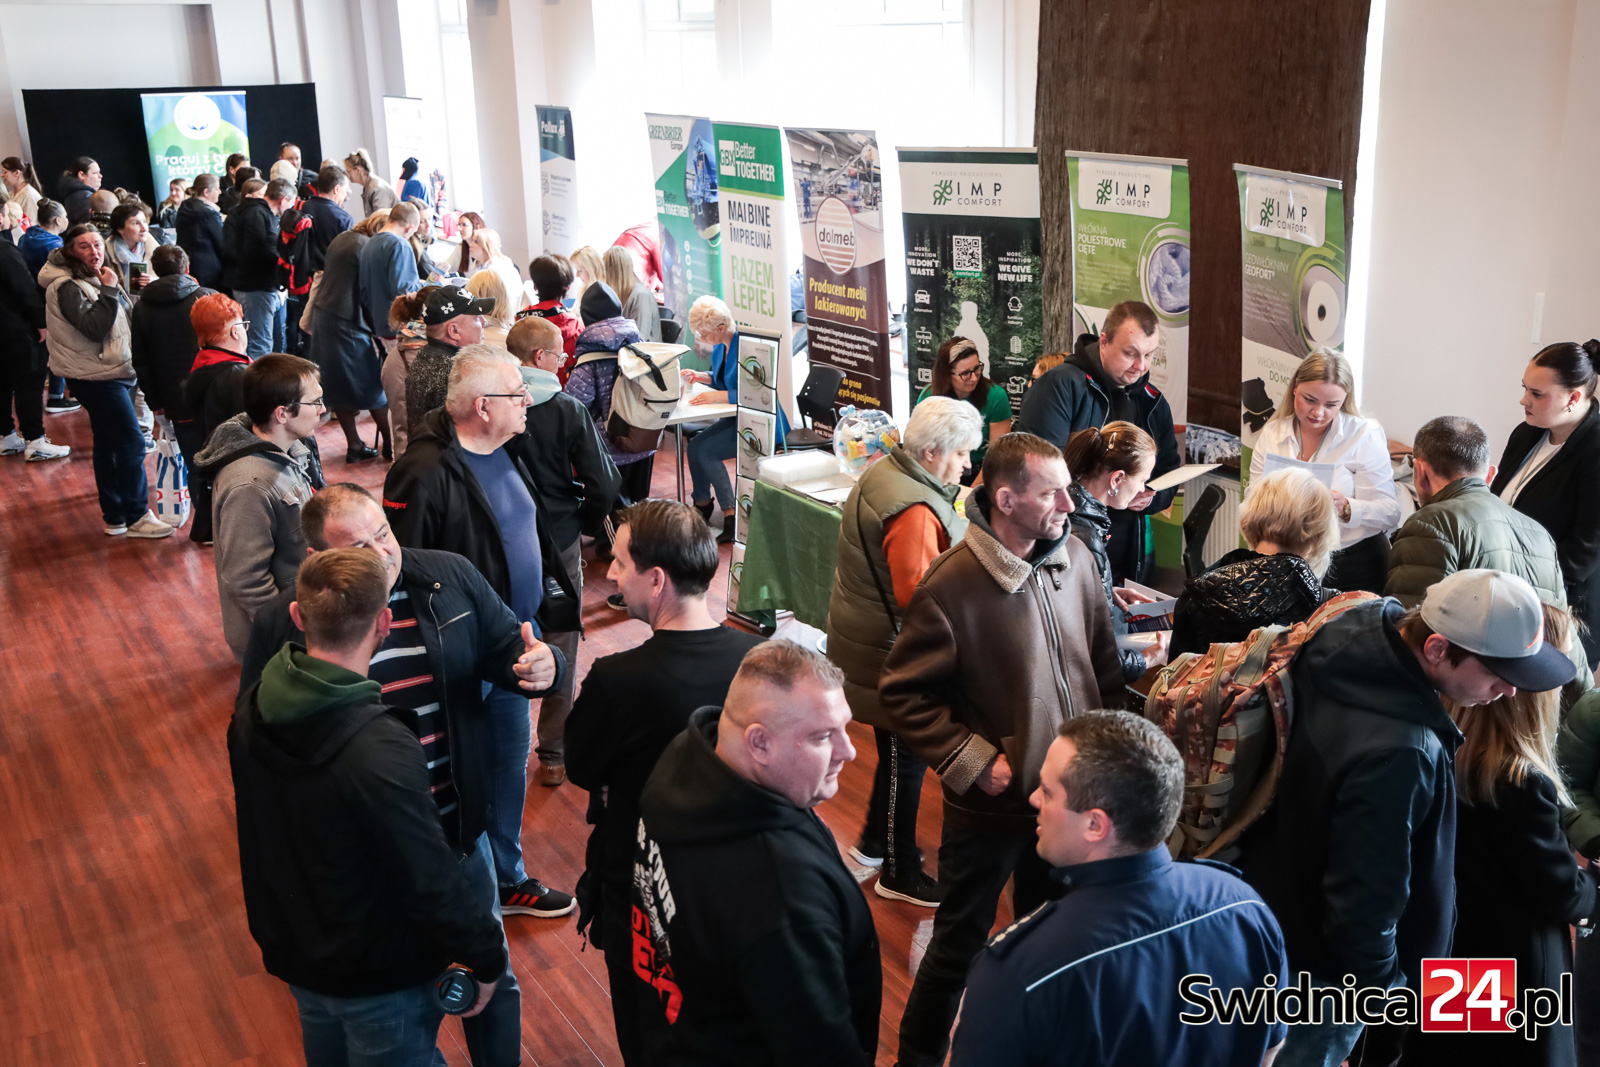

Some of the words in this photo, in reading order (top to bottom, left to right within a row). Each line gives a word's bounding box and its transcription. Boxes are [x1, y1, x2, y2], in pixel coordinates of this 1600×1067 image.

[648, 124, 683, 140] GREENBRIER
[670, 141, 683, 151] Europe
[734, 141, 756, 160] Better
[155, 152, 200, 166] Pracuj
[720, 149, 736, 167] GBX
[168, 163, 210, 176] którzy
[735, 161, 776, 182] TOGETHER
[957, 182, 1002, 197] IMP
[1115, 181, 1150, 198] IMP
[957, 197, 1002, 206] COMFORT
[1115, 198, 1150, 209] COMFORT
[664, 203, 689, 218] TOGETHER
[728, 200, 747, 223] MAI
[747, 203, 771, 228] BINE
[1277, 201, 1308, 223] IMP
[1078, 222, 1108, 235] WŁÓKNA
[1277, 220, 1307, 235] COMFORT
[729, 222, 772, 250] ÎMPREUNĂ
[818, 227, 855, 246] dolmeb
[1077, 233, 1127, 249] POLIESTROWE
[1077, 243, 1096, 255] CIĘTE
[906, 258, 917, 267] WE
[917, 258, 940, 268] DON'T
[998, 264, 1011, 273] WE
[1012, 265, 1031, 273] GIVE
[730, 254, 775, 290] RAZEM
[909, 267, 935, 276] WASTE
[997, 273, 1017, 282] NEW
[1016, 274, 1033, 283] LIFE
[809, 277, 846, 298] Producent
[847, 284, 867, 302] mebli
[732, 281, 775, 318] LEPIEJ
[814, 295, 867, 322] lakierowanych
[1269, 370, 1279, 383] DO
[848, 379, 862, 390] grona
